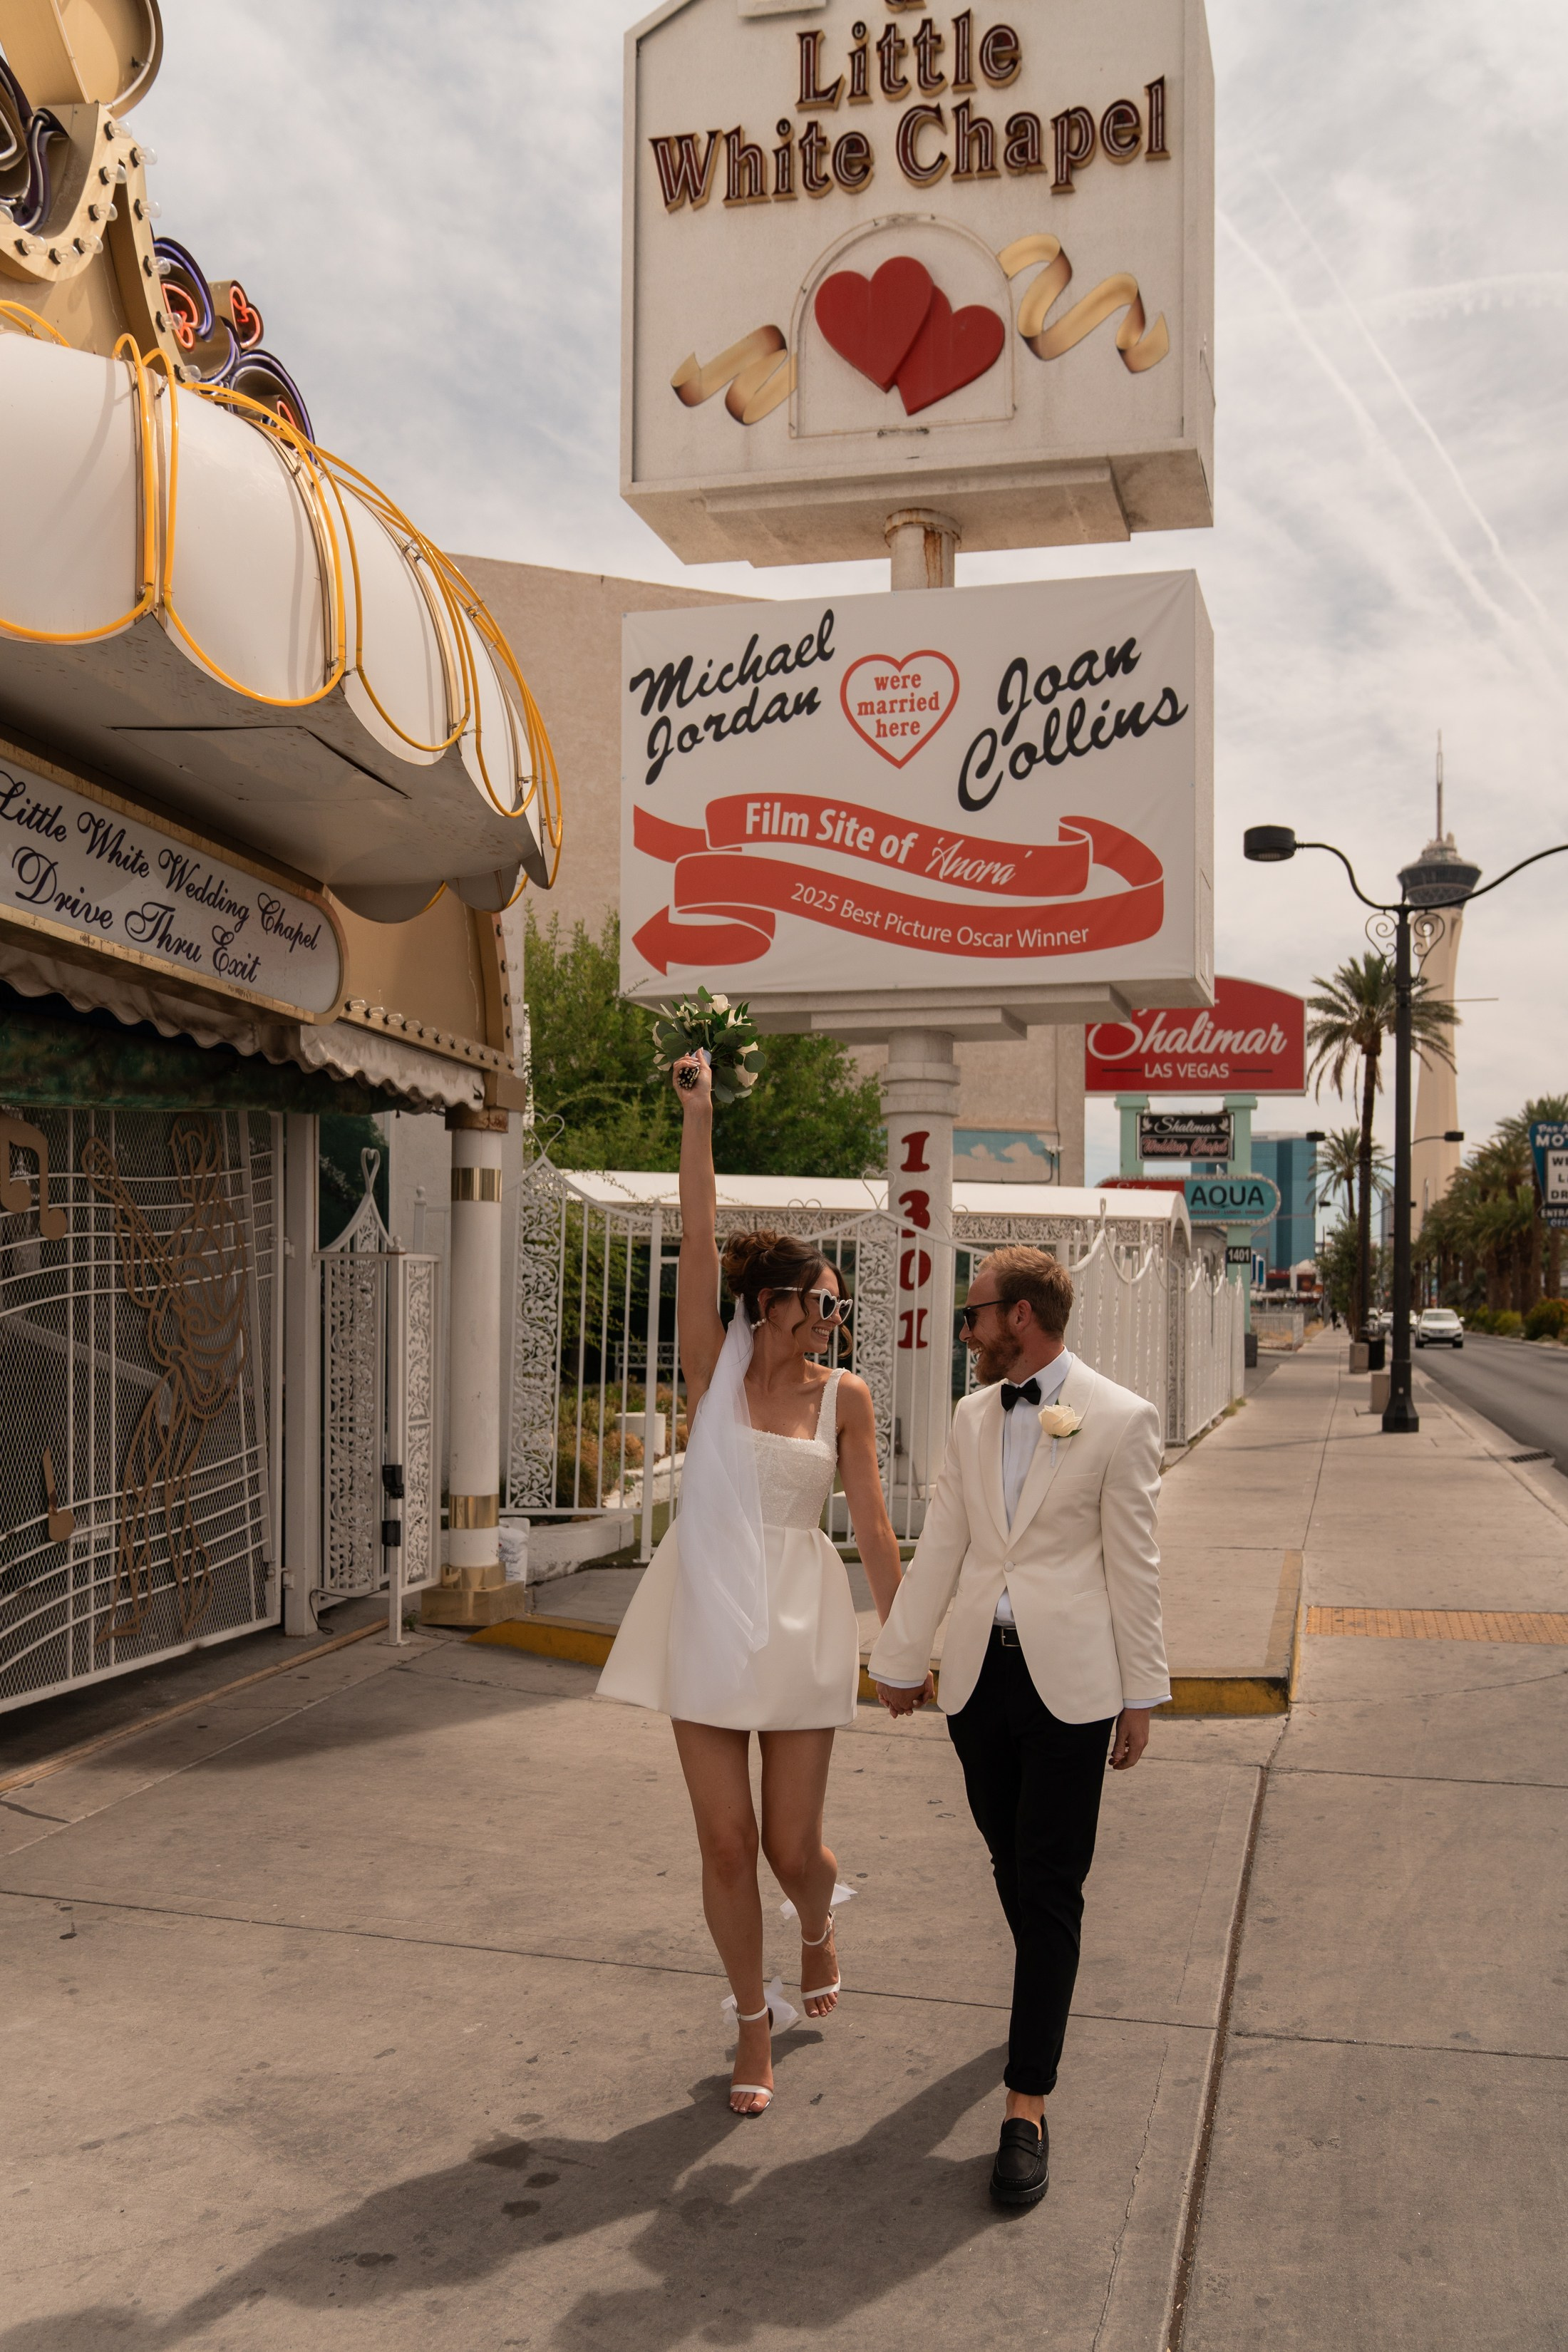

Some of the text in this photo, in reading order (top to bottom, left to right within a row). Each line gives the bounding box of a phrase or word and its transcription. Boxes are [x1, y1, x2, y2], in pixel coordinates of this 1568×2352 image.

[795, 9, 1022, 112] Little
[649, 74, 1171, 214] White Chapel
[629, 609, 835, 717] Michael
[857, 691, 940, 716] married
[874, 674, 922, 691] were
[997, 636, 1142, 746] Joan
[645, 686, 821, 785] Jordan
[875, 718, 921, 738] here
[958, 687, 1189, 812] Collins
[0, 770, 321, 953] Little White Wedding Chapel
[746, 802, 810, 837] Film
[815, 808, 875, 852] Site
[880, 832, 919, 864] of
[11, 846, 261, 983] Drive Thru Exit
[790, 882, 1089, 948] 2025 Best Picture Oscar Winner
[1144, 1063, 1229, 1078] LAS VEGAS
[1154, 1116, 1217, 1134] Shalimar
[1190, 1185, 1264, 1207] AQUA
[897, 1131, 932, 1348] 1301
[1228, 1248, 1250, 1262] 1401
